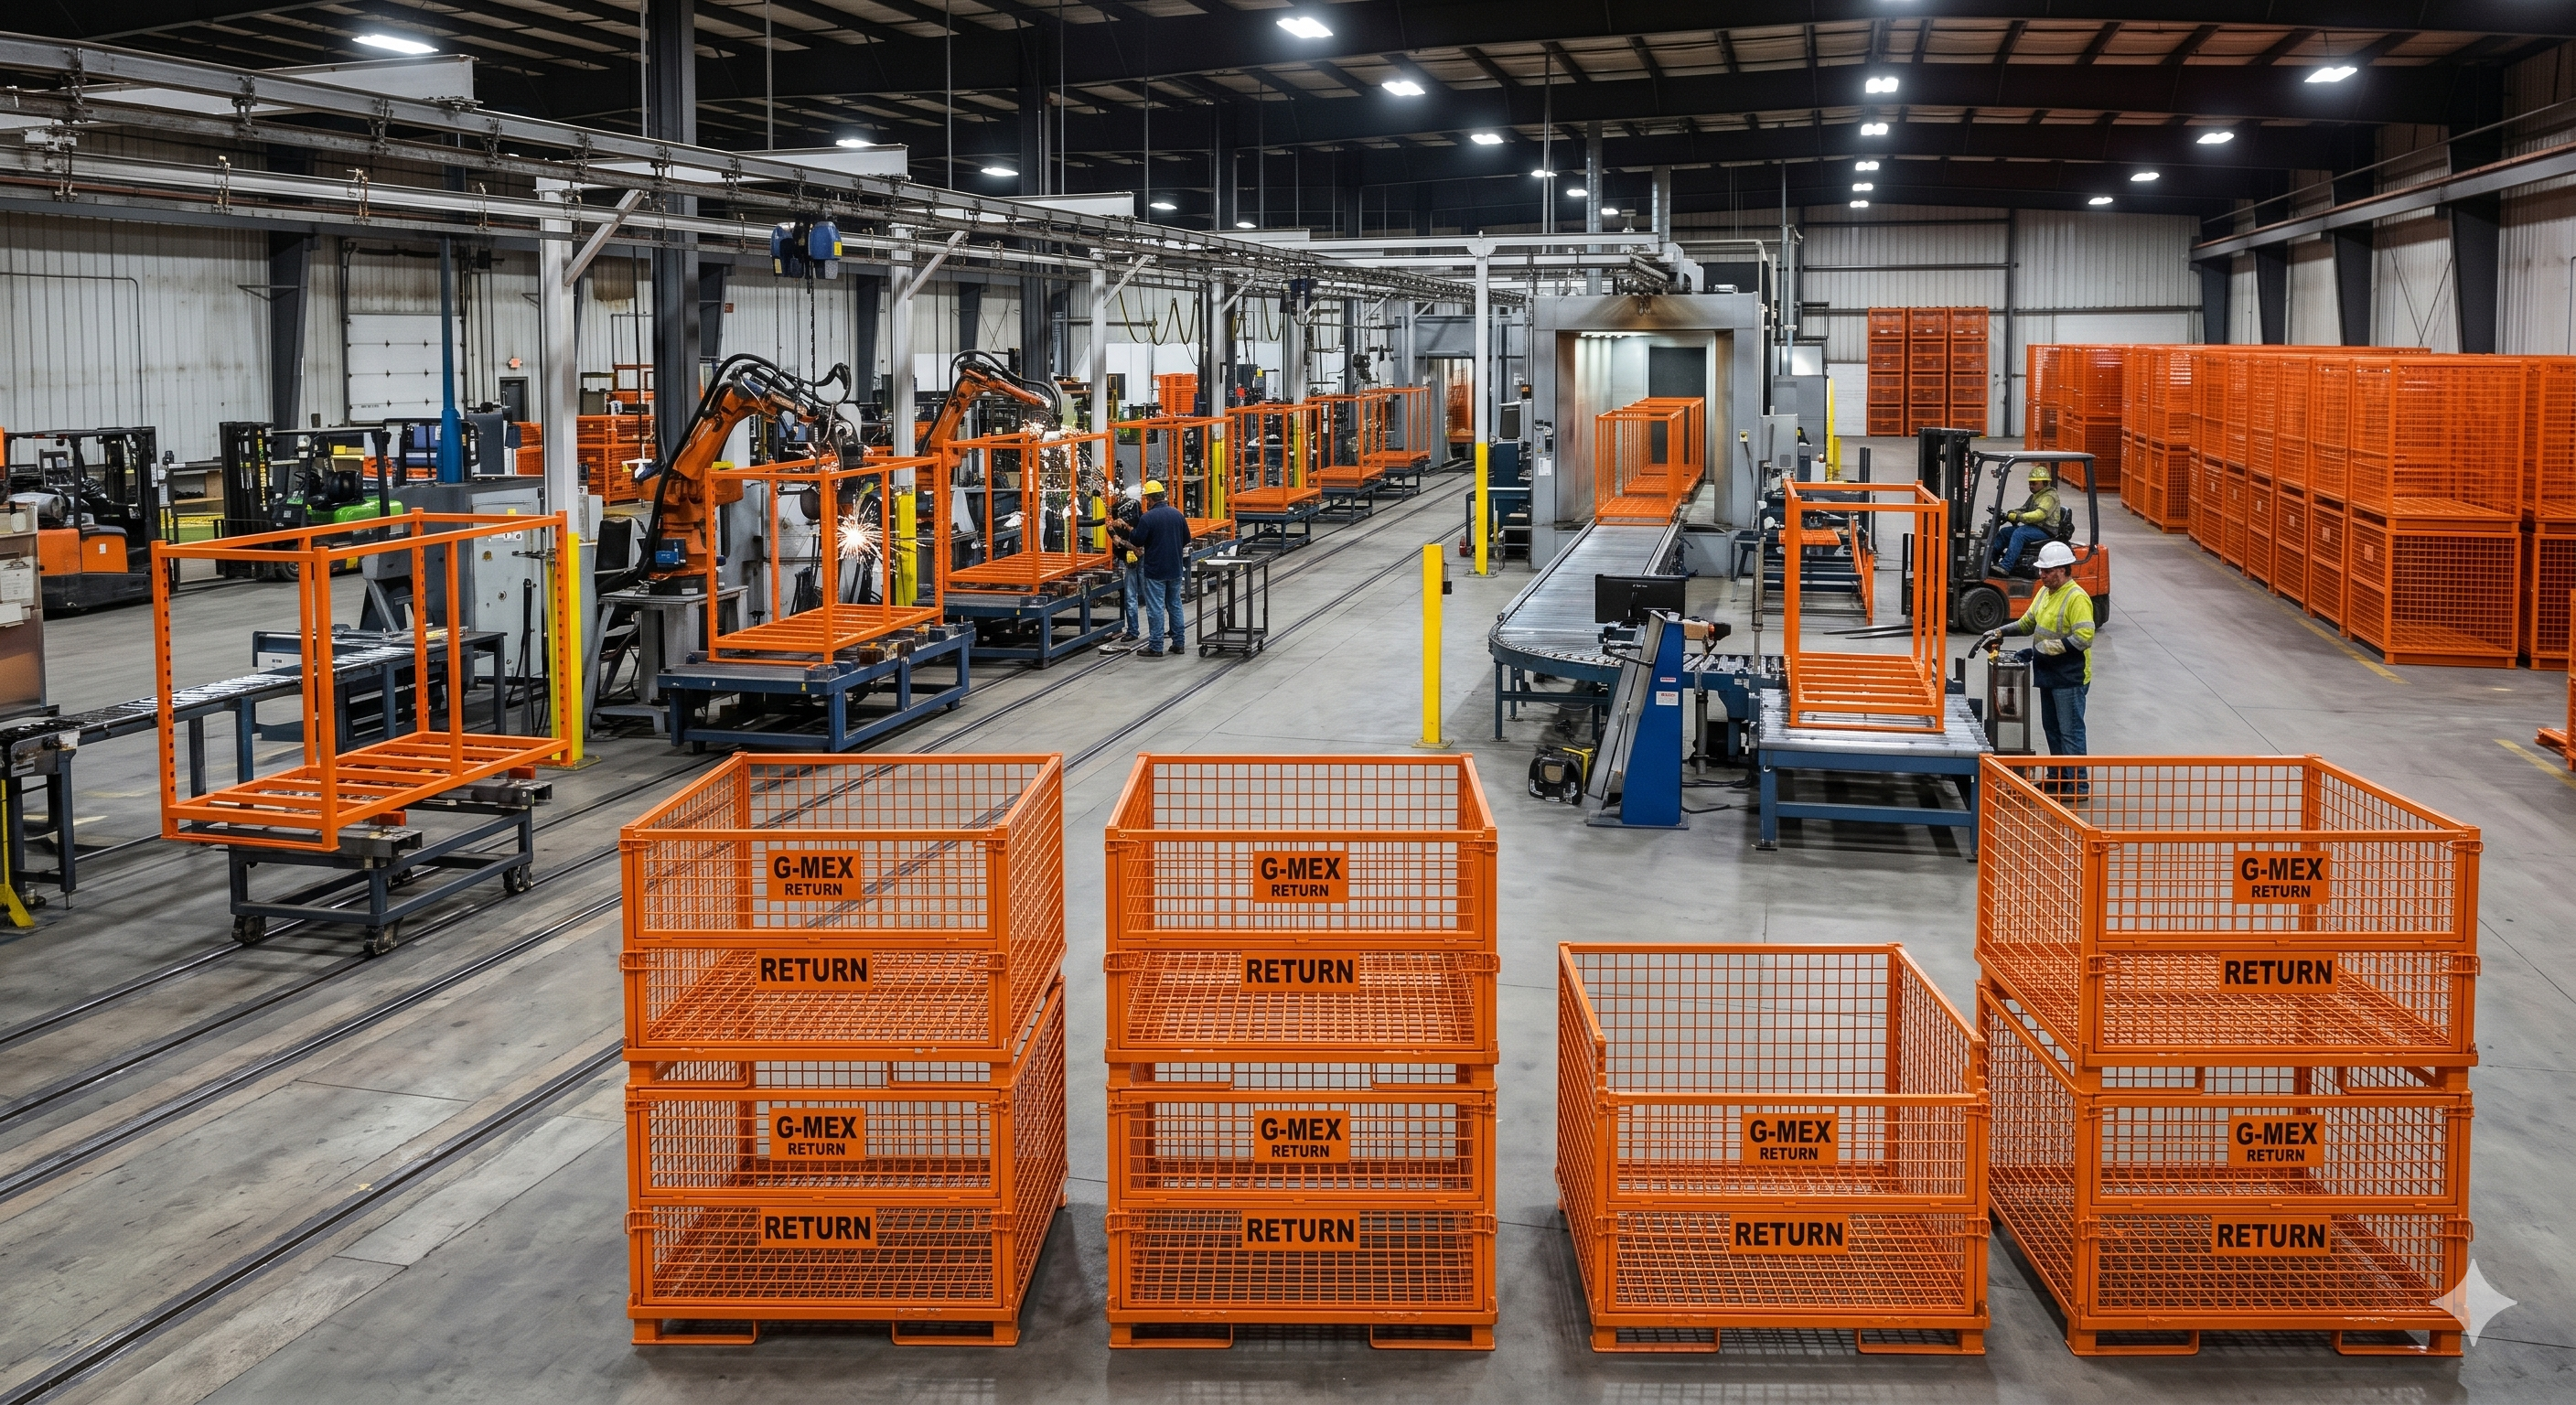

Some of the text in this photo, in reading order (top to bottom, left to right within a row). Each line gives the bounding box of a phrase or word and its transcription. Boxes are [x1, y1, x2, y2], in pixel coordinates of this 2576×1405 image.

[773, 855, 854, 879] G-MEX
[1261, 857, 1341, 881] G-MEX
[2241, 857, 2324, 882] G-MEX
[784, 883, 843, 896] RETURN
[1271, 884, 1329, 897] RETURN
[2251, 885, 2311, 898] RETURN
[760, 957, 867, 982] RETURN
[1246, 959, 1354, 984] RETURN
[2225, 960, 2333, 985] RETURN
[776, 1115, 857, 1139] G-MEX
[1261, 1117, 1342, 1141] G-MEX
[1749, 1120, 1831, 1143] G-MEX
[2236, 1121, 2318, 1146] G-MEX
[788, 1142, 846, 1156] RETURN
[1272, 1144, 1330, 1158] RETURN
[1759, 1147, 1819, 1161] RETURN
[2247, 1148, 2305, 1163] RETURN
[765, 1216, 871, 1240] RETURN
[1247, 1217, 1355, 1243] RETURN
[1735, 1221, 1843, 1247] RETURN
[2217, 1223, 2325, 1249] RETURN
